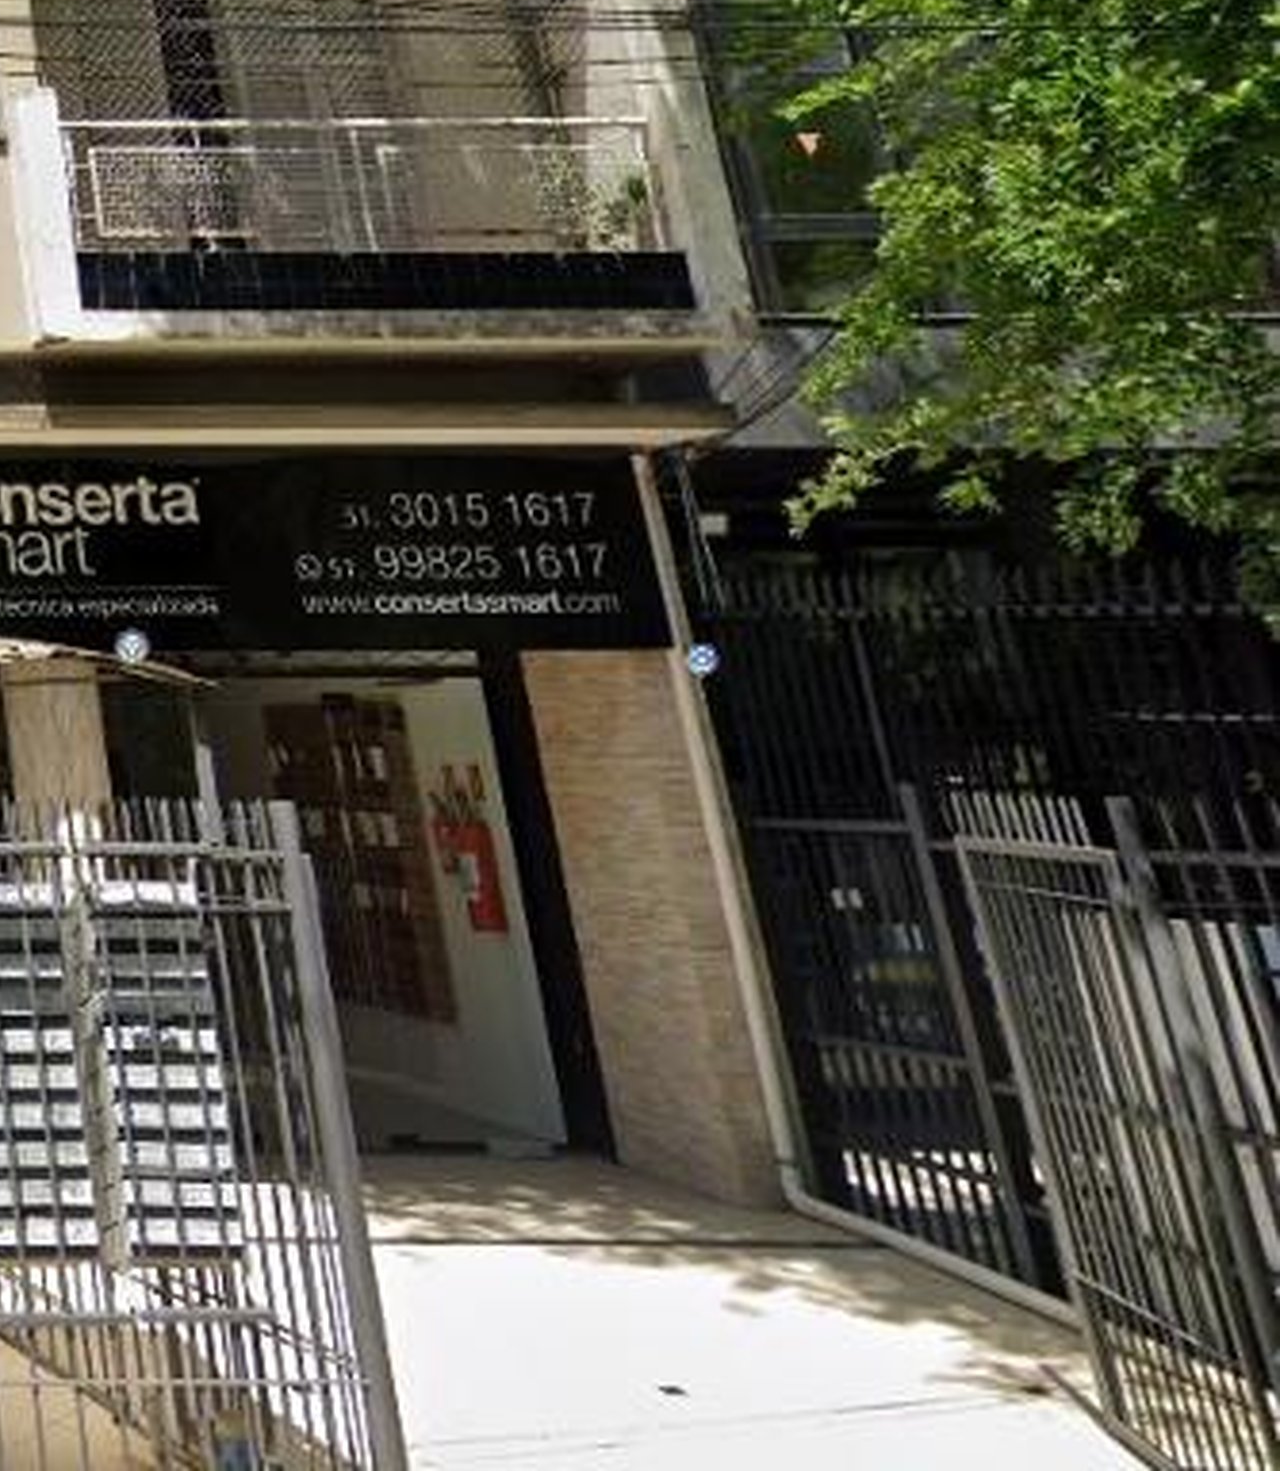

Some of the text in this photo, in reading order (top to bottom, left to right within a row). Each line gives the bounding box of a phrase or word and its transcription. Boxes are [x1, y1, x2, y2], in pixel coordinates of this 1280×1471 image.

[390, 492, 490, 528] 3015
[505, 492, 594, 527] 1617
[373, 545, 503, 580] 99825
[517, 543, 607, 579] 1617
